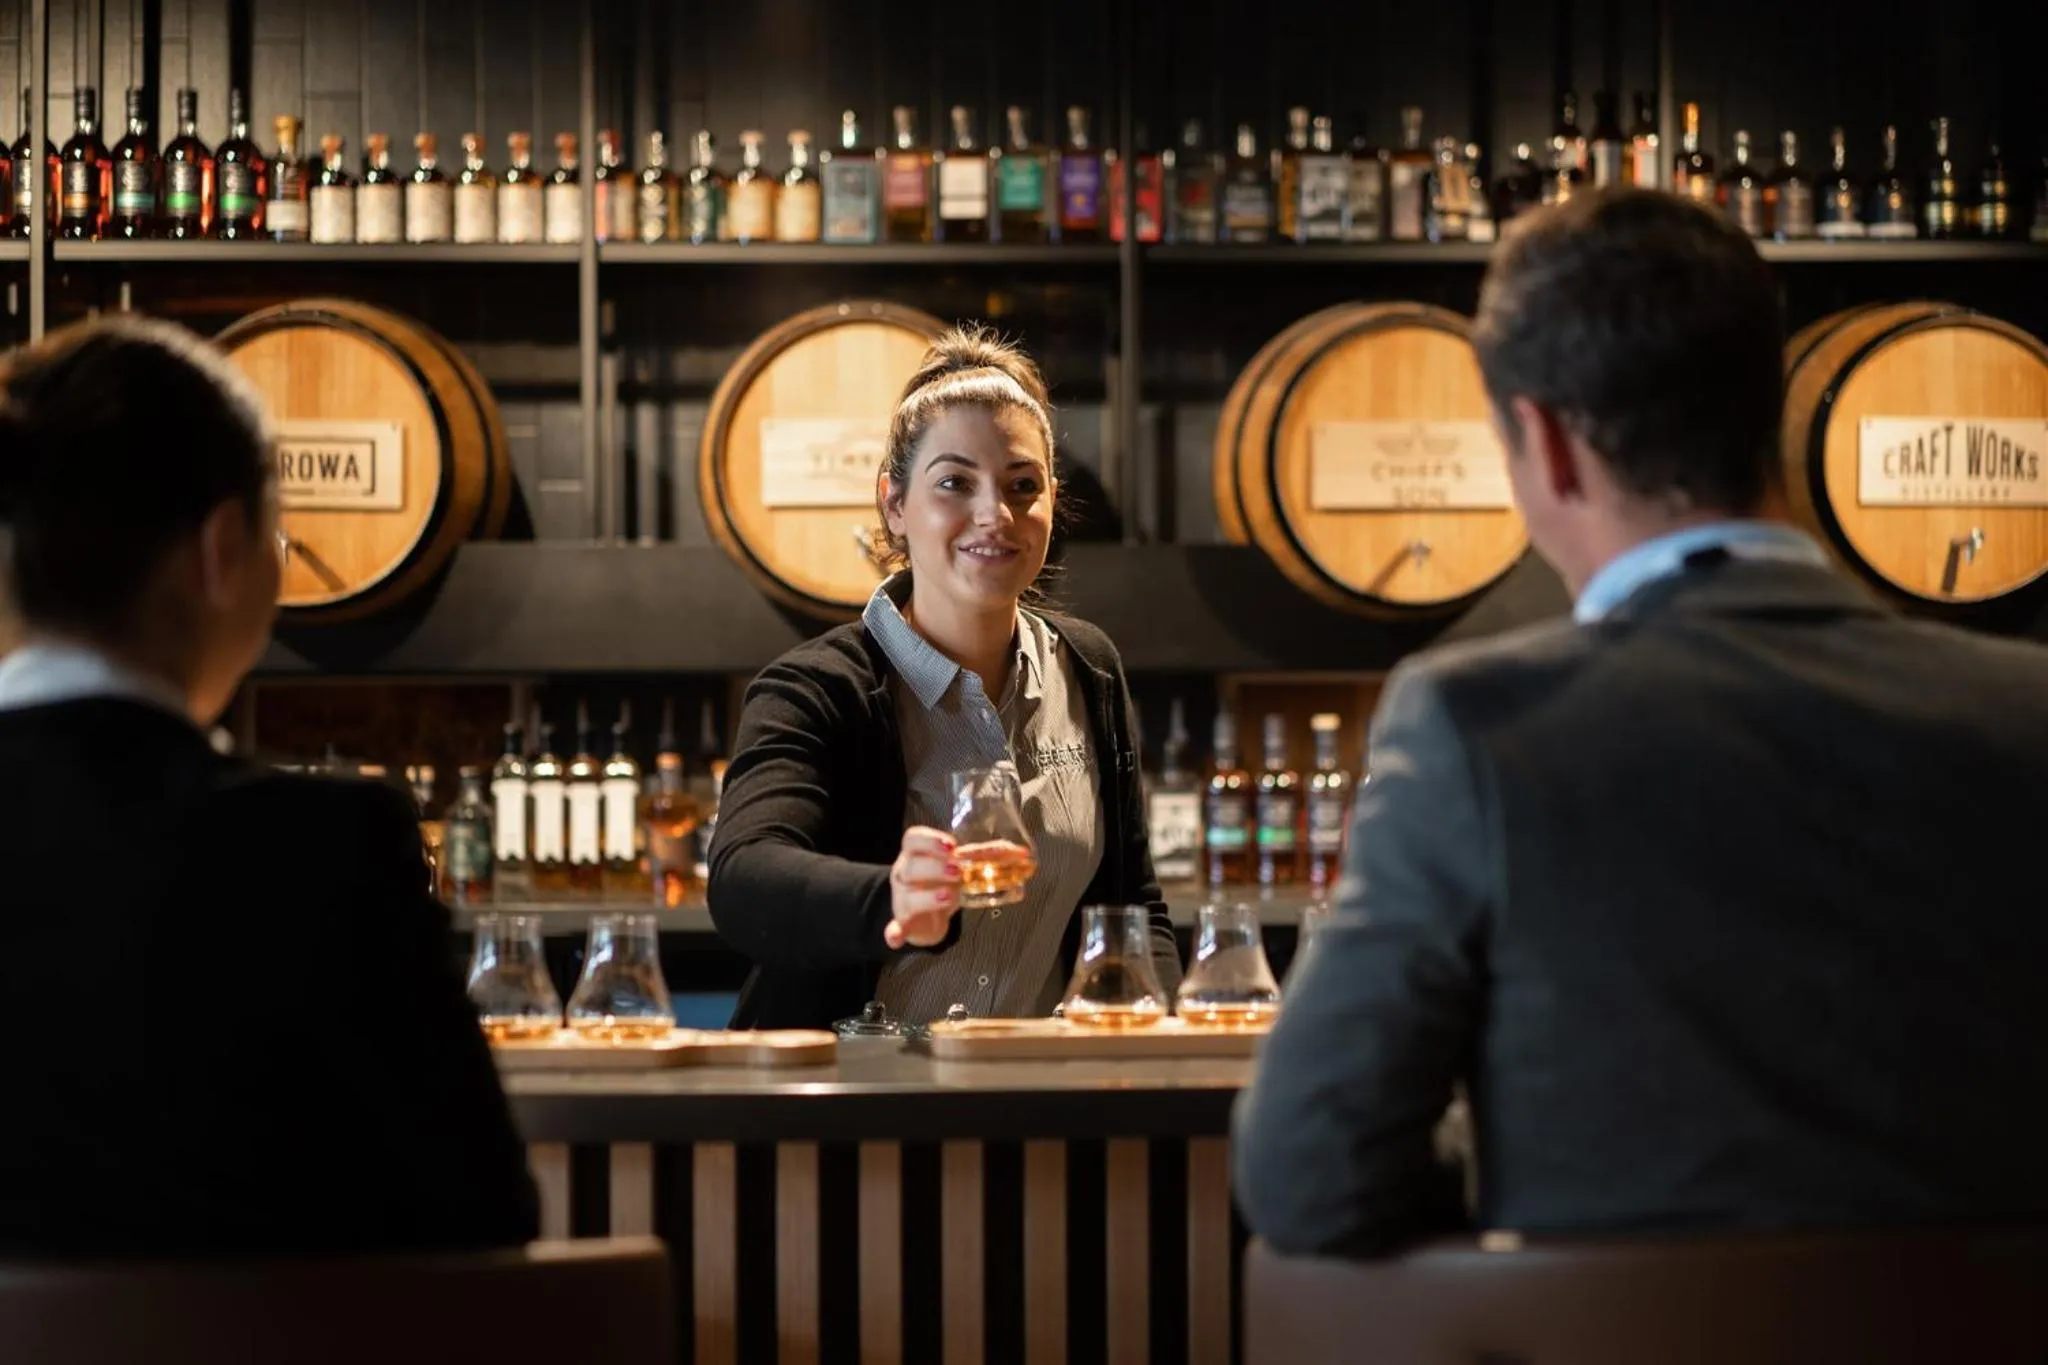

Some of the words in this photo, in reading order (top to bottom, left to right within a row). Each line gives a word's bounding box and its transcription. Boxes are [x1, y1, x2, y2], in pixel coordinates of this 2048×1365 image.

[280, 451, 360, 482] ROWA
[1883, 421, 1954, 479] CRAFT
[1966, 424, 2039, 481] WORKS
